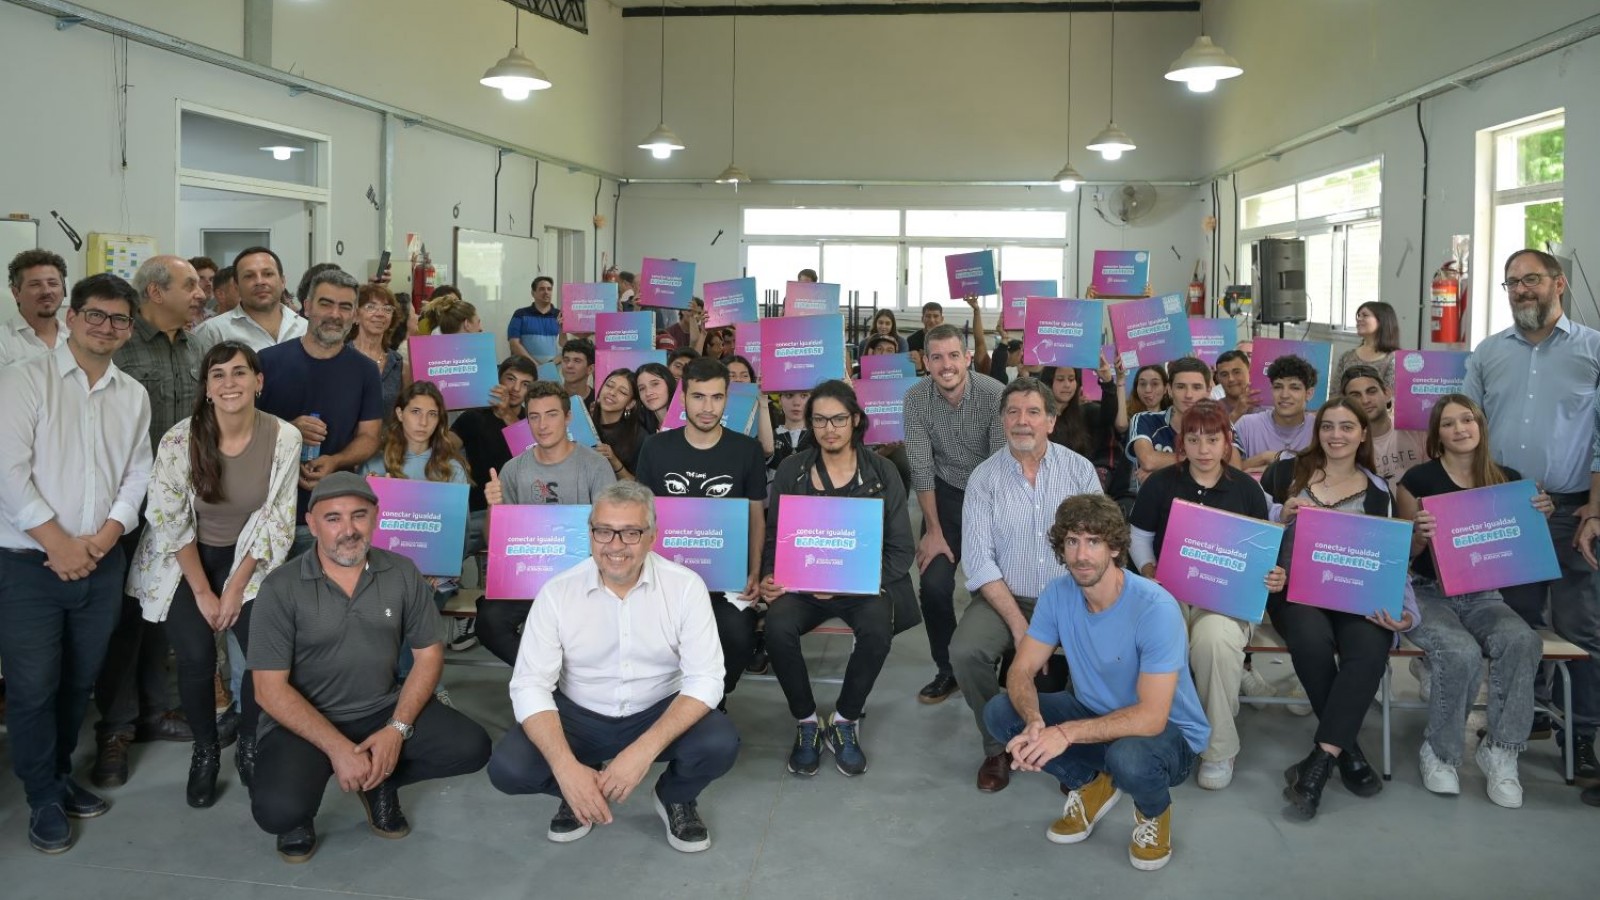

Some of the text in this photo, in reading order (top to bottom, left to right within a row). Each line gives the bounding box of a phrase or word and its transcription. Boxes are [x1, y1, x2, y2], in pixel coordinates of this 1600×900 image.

[413, 511, 441, 520] igualdad
[695, 528, 723, 536] igualdad
[1451, 517, 1516, 535] conectar igualdad
[826, 529, 855, 537] igualdad
[1184, 537, 1248, 559] conectar igualdad
[1315, 541, 1380, 558] conectar igualdad
